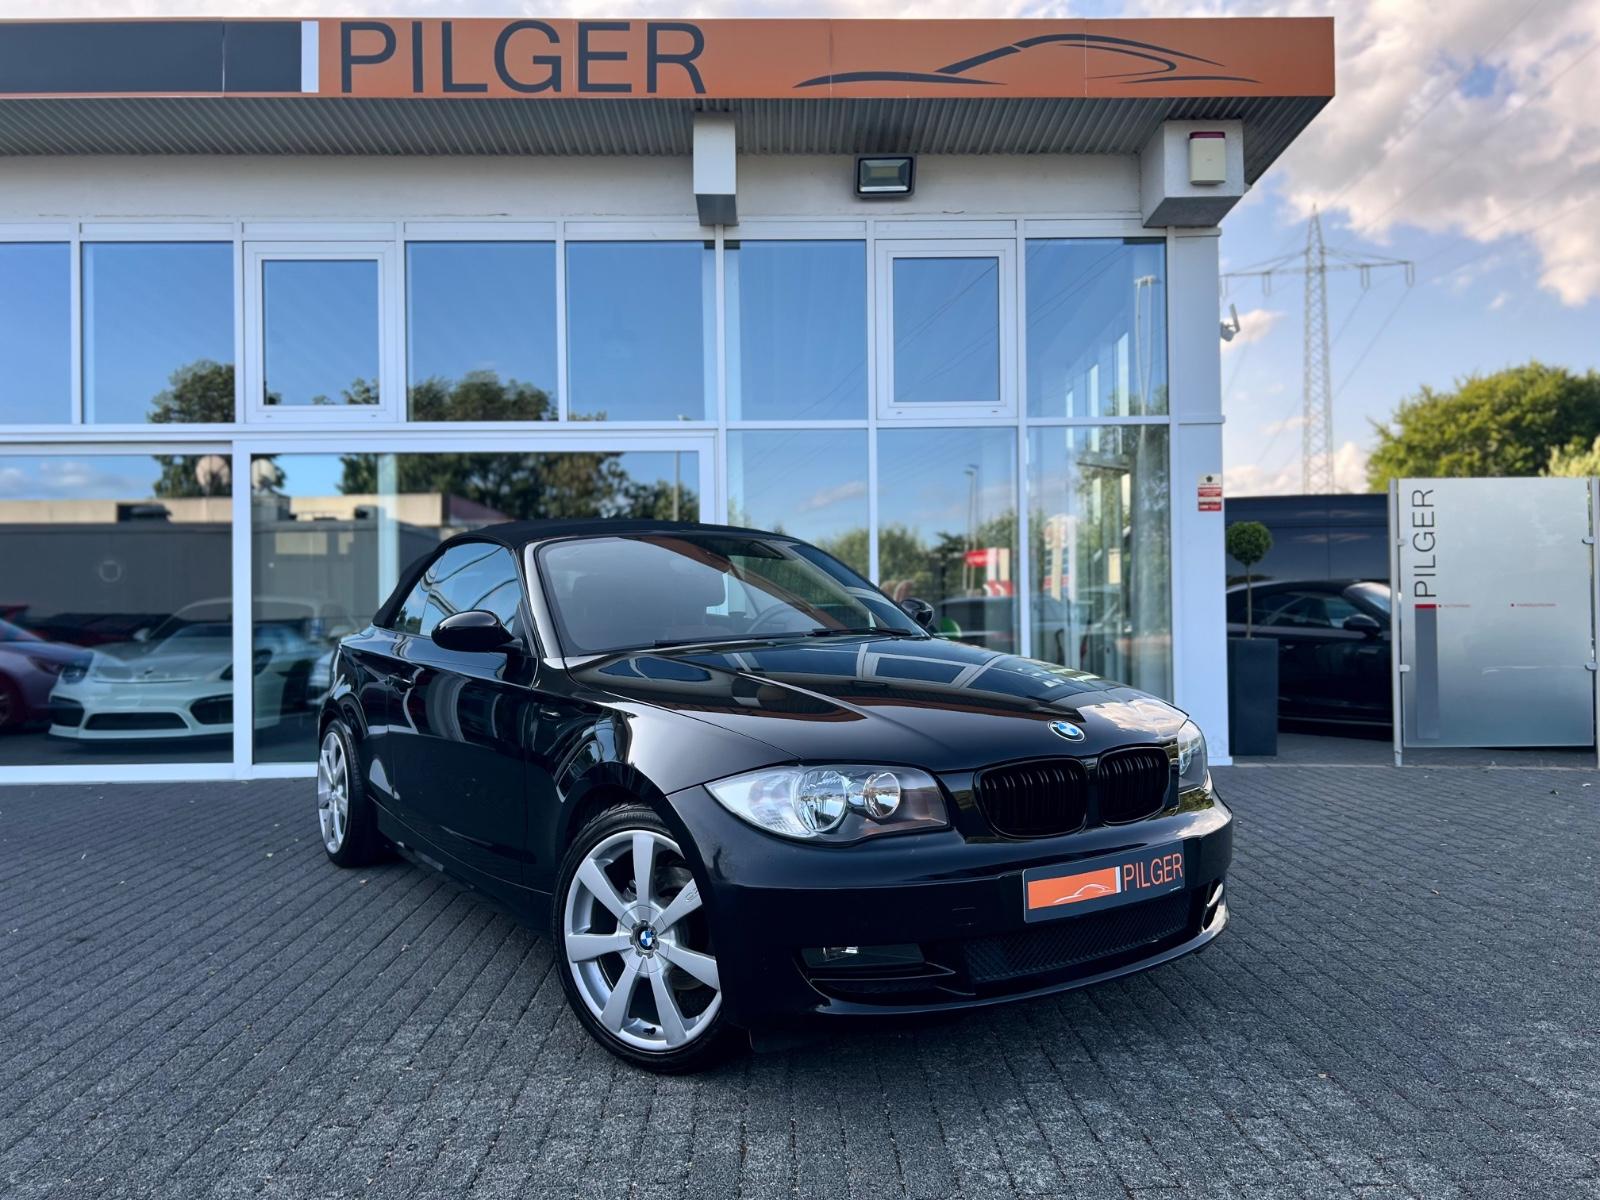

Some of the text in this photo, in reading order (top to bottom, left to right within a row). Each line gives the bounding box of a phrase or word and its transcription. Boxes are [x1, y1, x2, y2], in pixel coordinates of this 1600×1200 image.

[340, 20, 706, 93] PILGER
[1412, 489, 1437, 597] PILGER
[1123, 853, 1183, 891] PILGER
